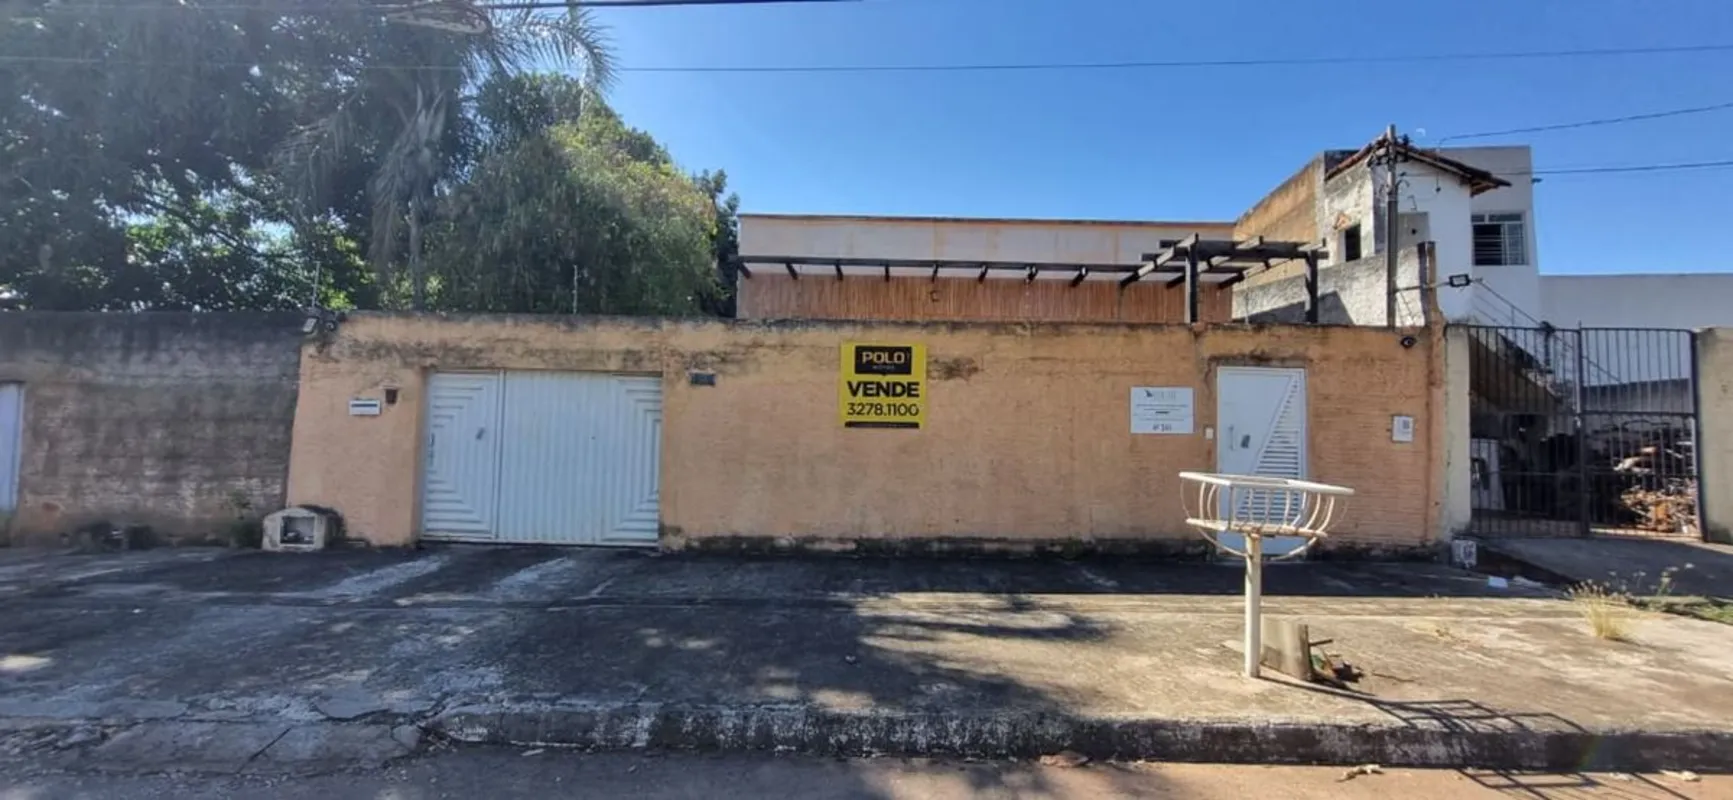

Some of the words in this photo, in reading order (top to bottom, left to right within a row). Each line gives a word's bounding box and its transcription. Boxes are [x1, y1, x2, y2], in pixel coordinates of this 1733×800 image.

[862, 351, 905, 364] POLO
[847, 381, 920, 398] VENDE
[847, 402, 920, 417] 3278.1100
